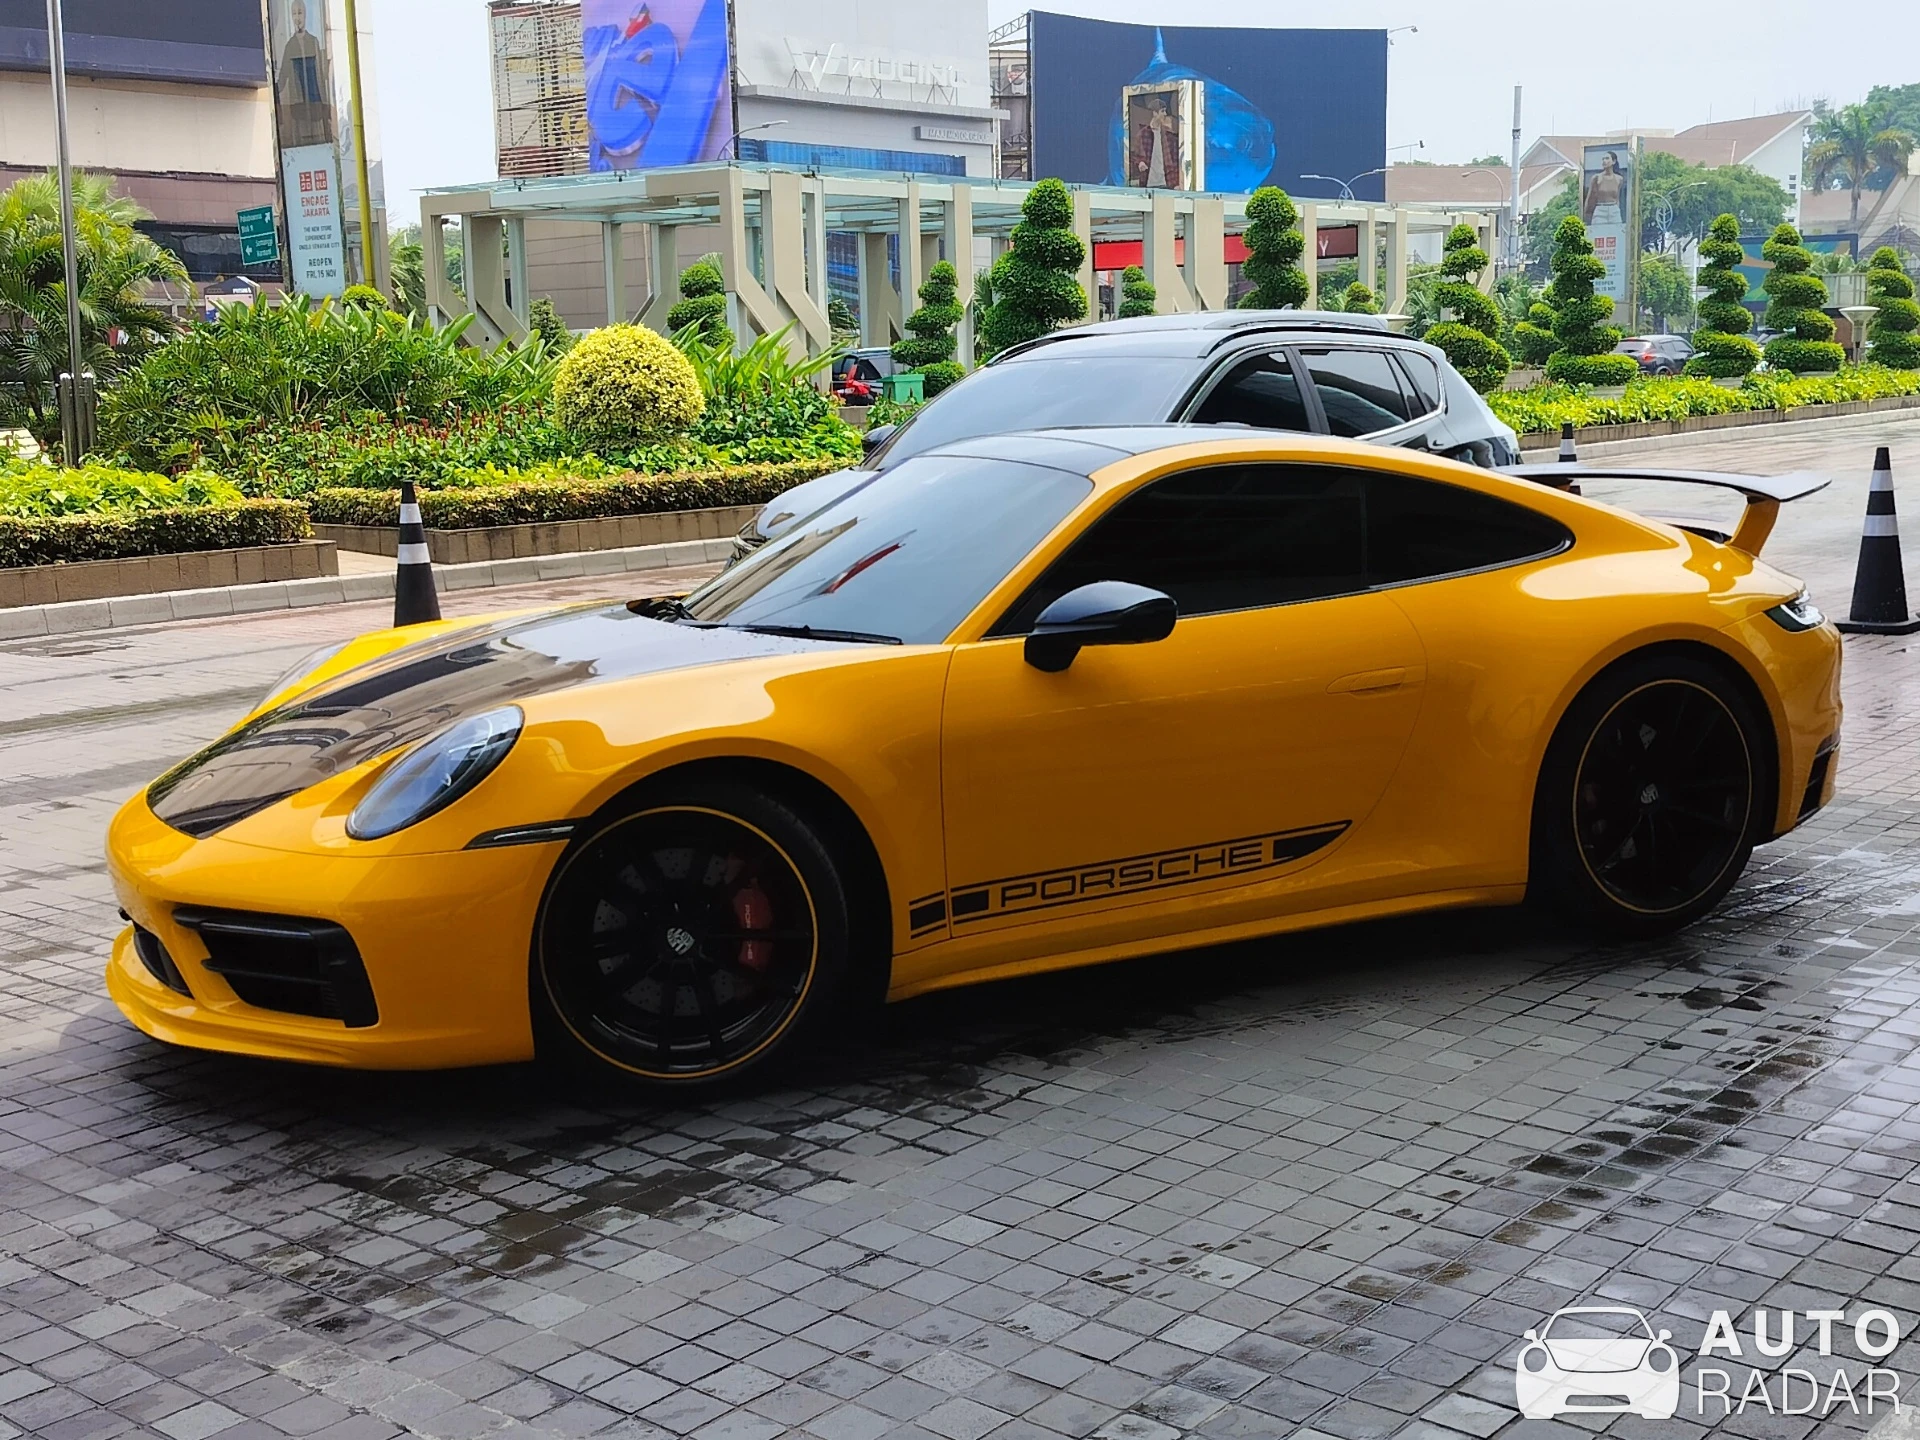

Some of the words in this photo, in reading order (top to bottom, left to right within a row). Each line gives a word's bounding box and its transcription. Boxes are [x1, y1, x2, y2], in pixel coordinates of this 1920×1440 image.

[301, 195, 330, 207] ENGAGE
[302, 207, 331, 218] JAKARTA
[308, 257, 333, 267] REOPEN
[317, 269, 325, 278] 15
[325, 268, 337, 278] NOV
[1000, 841, 1263, 908] PORSCHE
